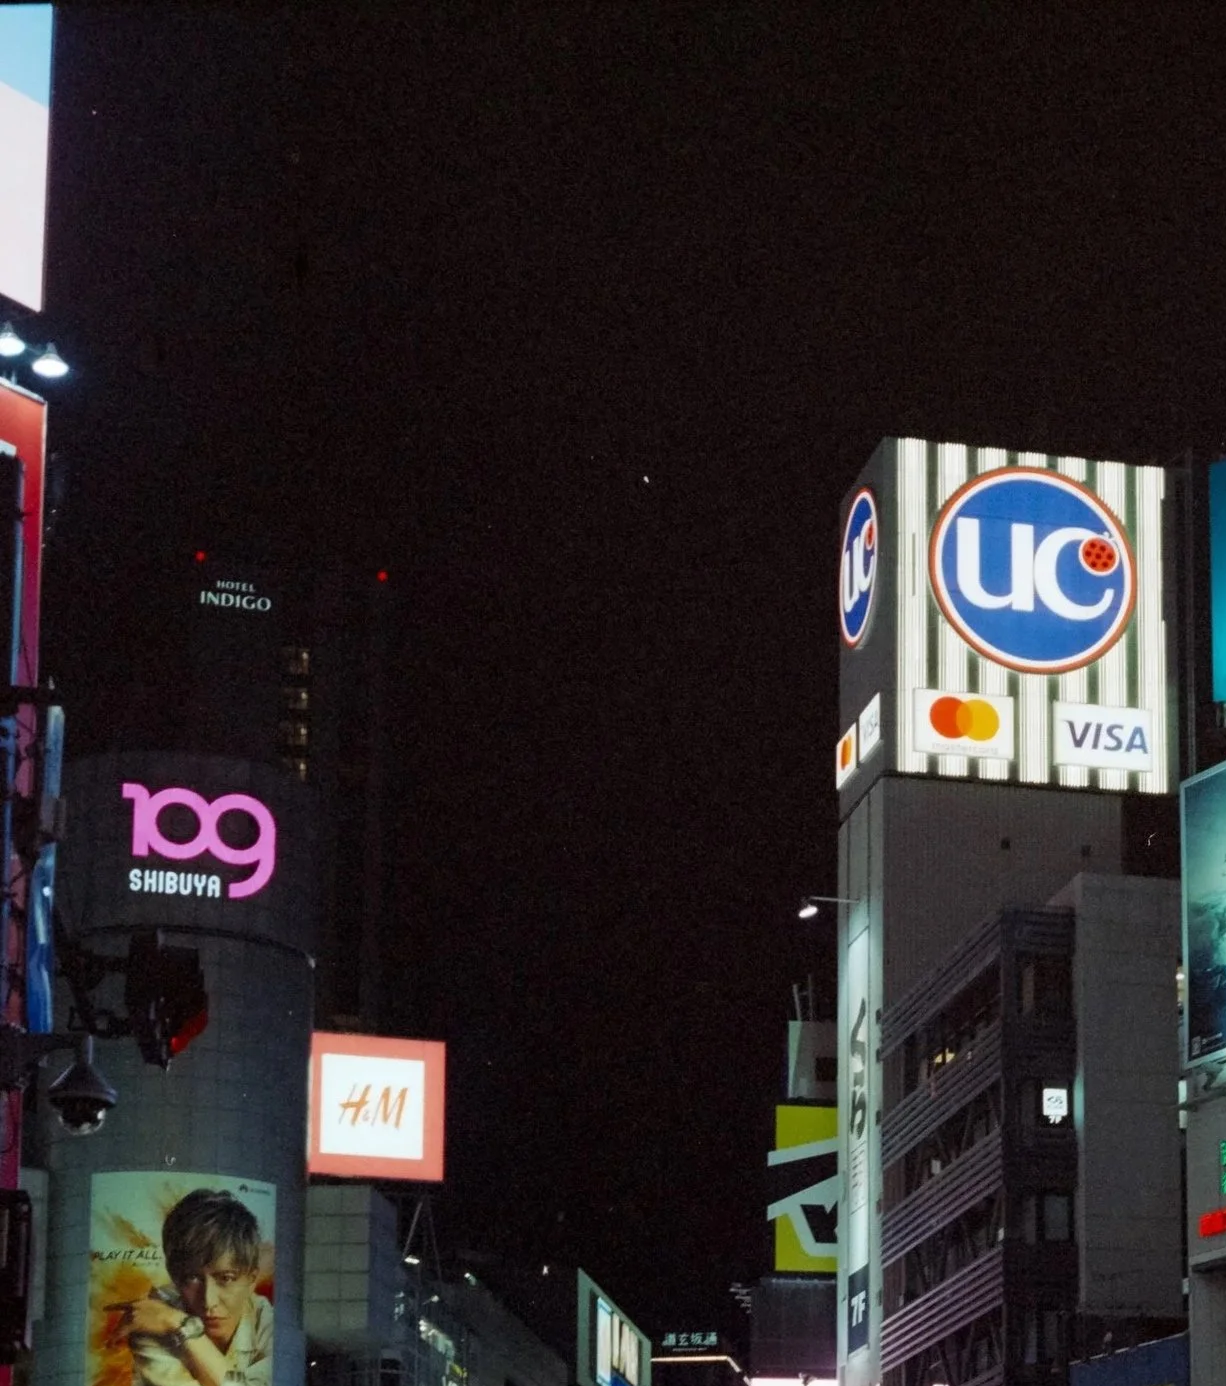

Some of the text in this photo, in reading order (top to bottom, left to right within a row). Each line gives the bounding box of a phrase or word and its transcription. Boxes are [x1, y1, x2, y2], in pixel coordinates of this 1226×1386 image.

[216, 580, 257, 592] HOTEL
[956, 517, 1116, 622] UC
[200, 590, 272, 612] INDIGO
[1065, 719, 1149, 755] VISA
[122, 783, 277, 899] 109
[129, 868, 221, 898] SHIBUYA
[338, 1083, 409, 1129] H&M
[94, 1249, 120, 1262] PLAY
[122, 1249, 134, 1260] IT
[850, 1290, 867, 1328] 7F
